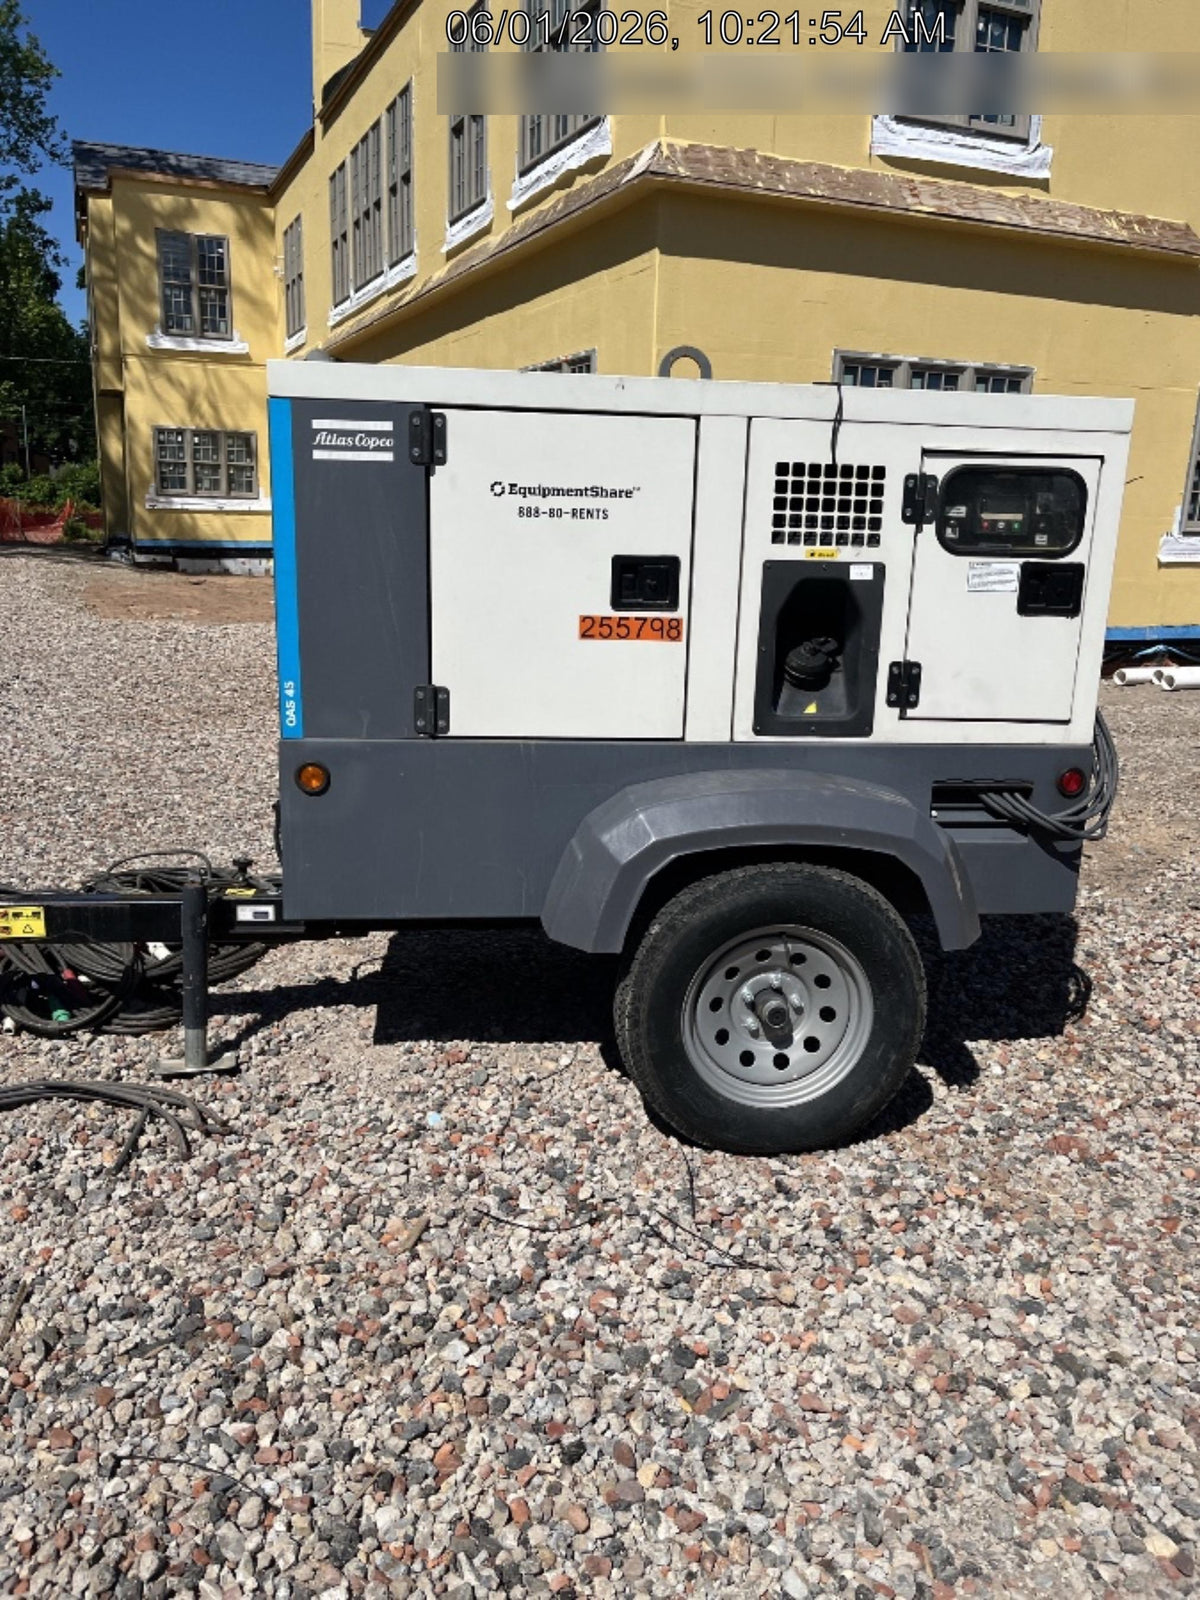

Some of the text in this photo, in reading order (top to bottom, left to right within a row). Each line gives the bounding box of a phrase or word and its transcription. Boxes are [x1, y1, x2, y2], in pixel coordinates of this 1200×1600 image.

[312, 431, 393, 450] Atlas Copco
[518, 506, 609, 520] 888-80-RENTS
[581, 616, 681, 639] 255798
[284, 680, 295, 698] 45
